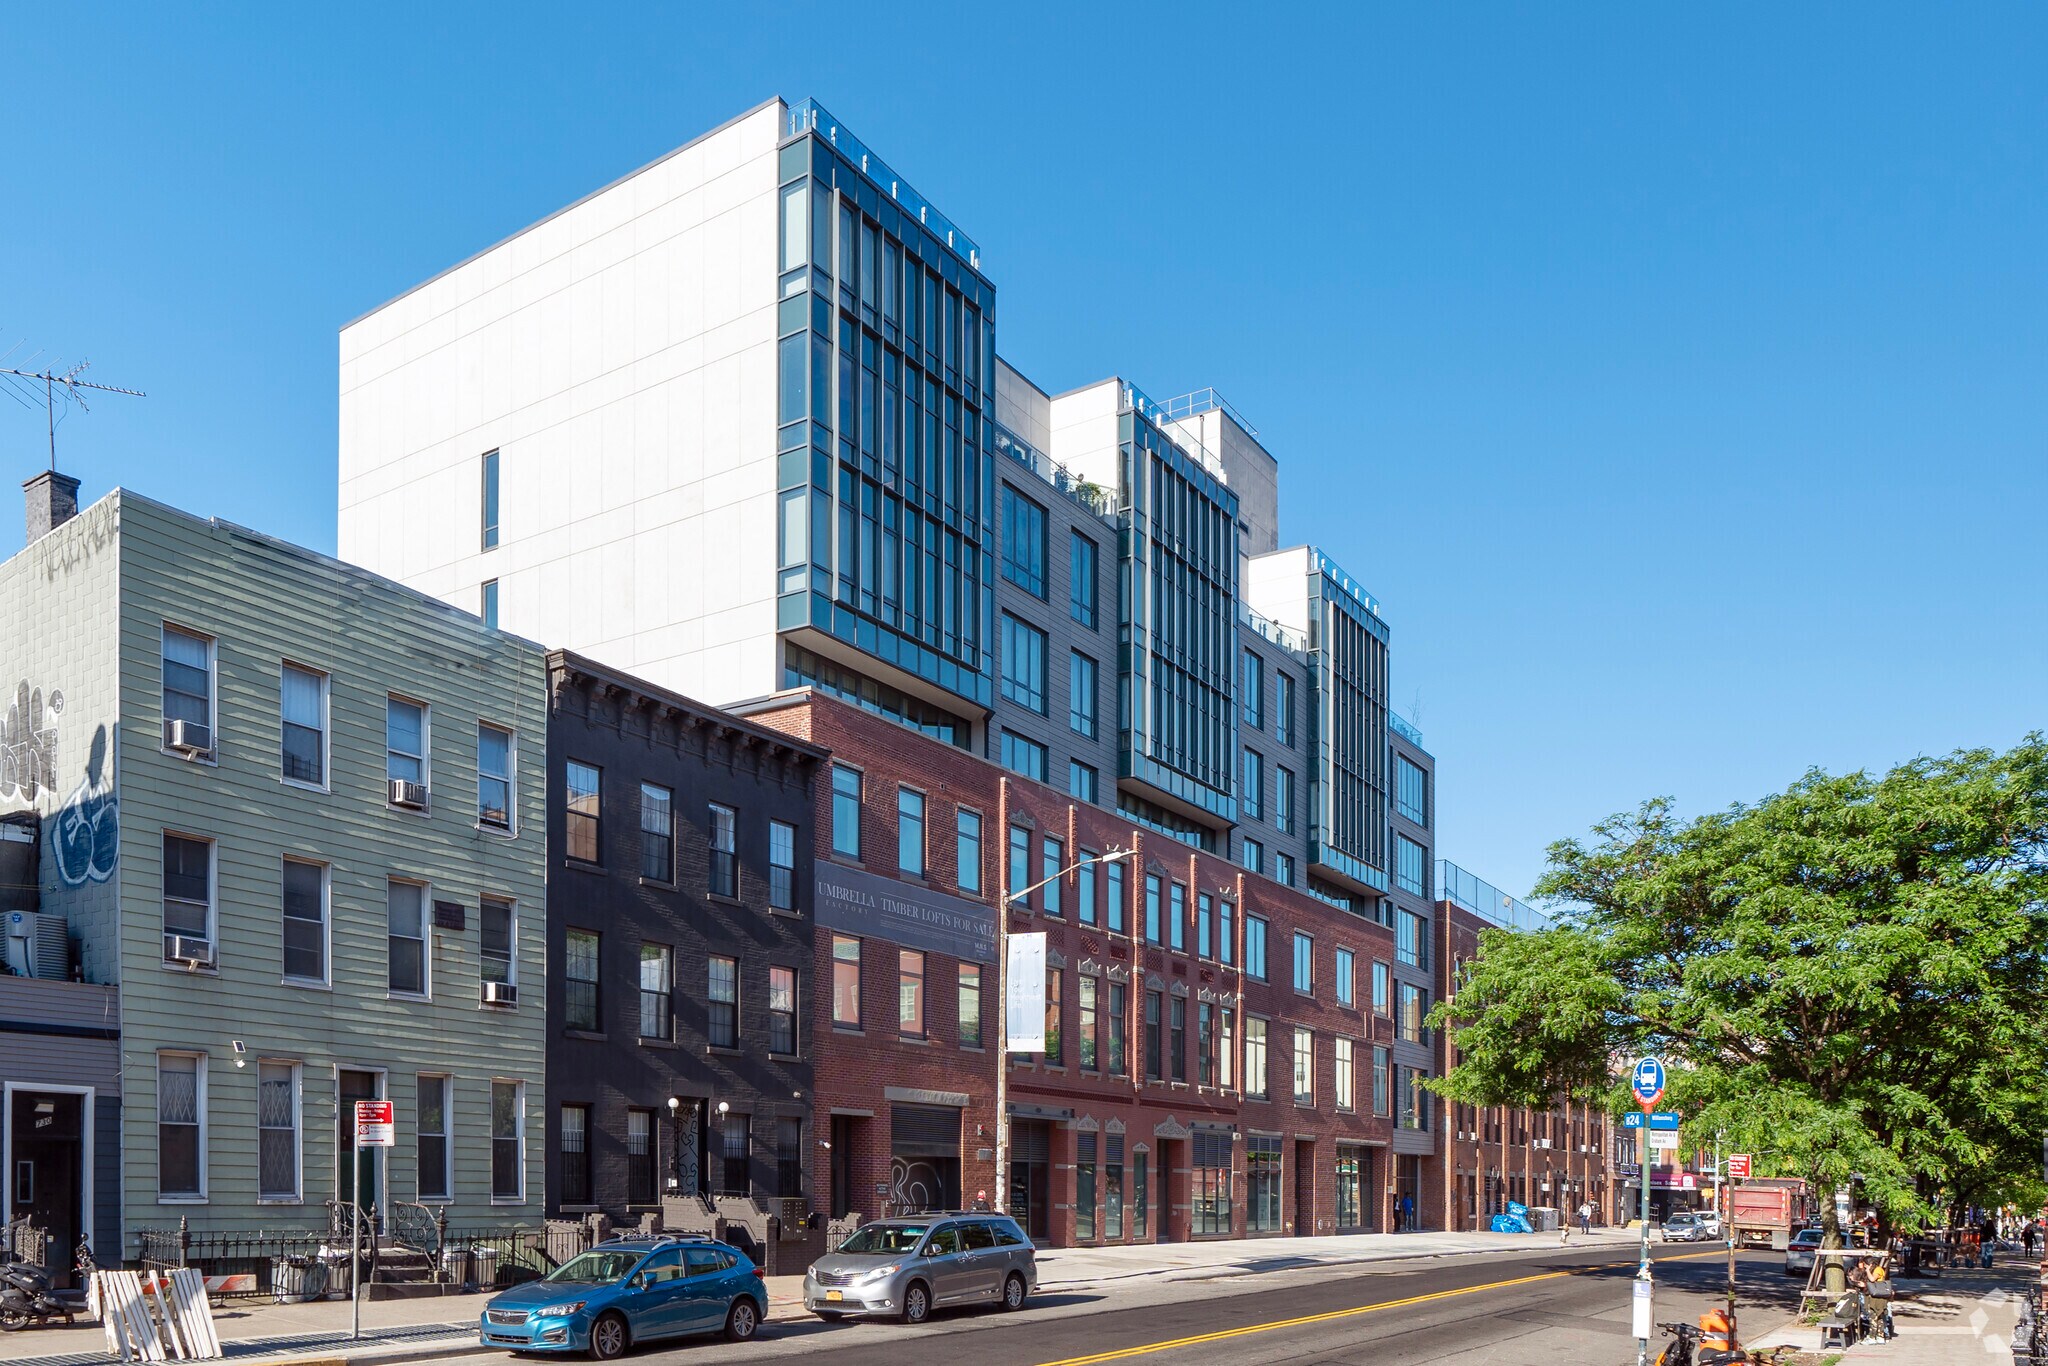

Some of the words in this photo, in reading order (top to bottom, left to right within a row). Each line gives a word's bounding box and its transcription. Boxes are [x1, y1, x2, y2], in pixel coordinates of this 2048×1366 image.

[817, 881, 875, 908] UMBRELLA
[880, 897, 919, 918] TIMBER
[921, 908, 951, 927] LOFTS
[953, 917, 971, 932] FOR
[973, 922, 995, 938] SALE
[825, 899, 869, 915] FACTORY
[36, 1117, 51, 1127] 730
[1625, 1114, 1640, 1126] B24
